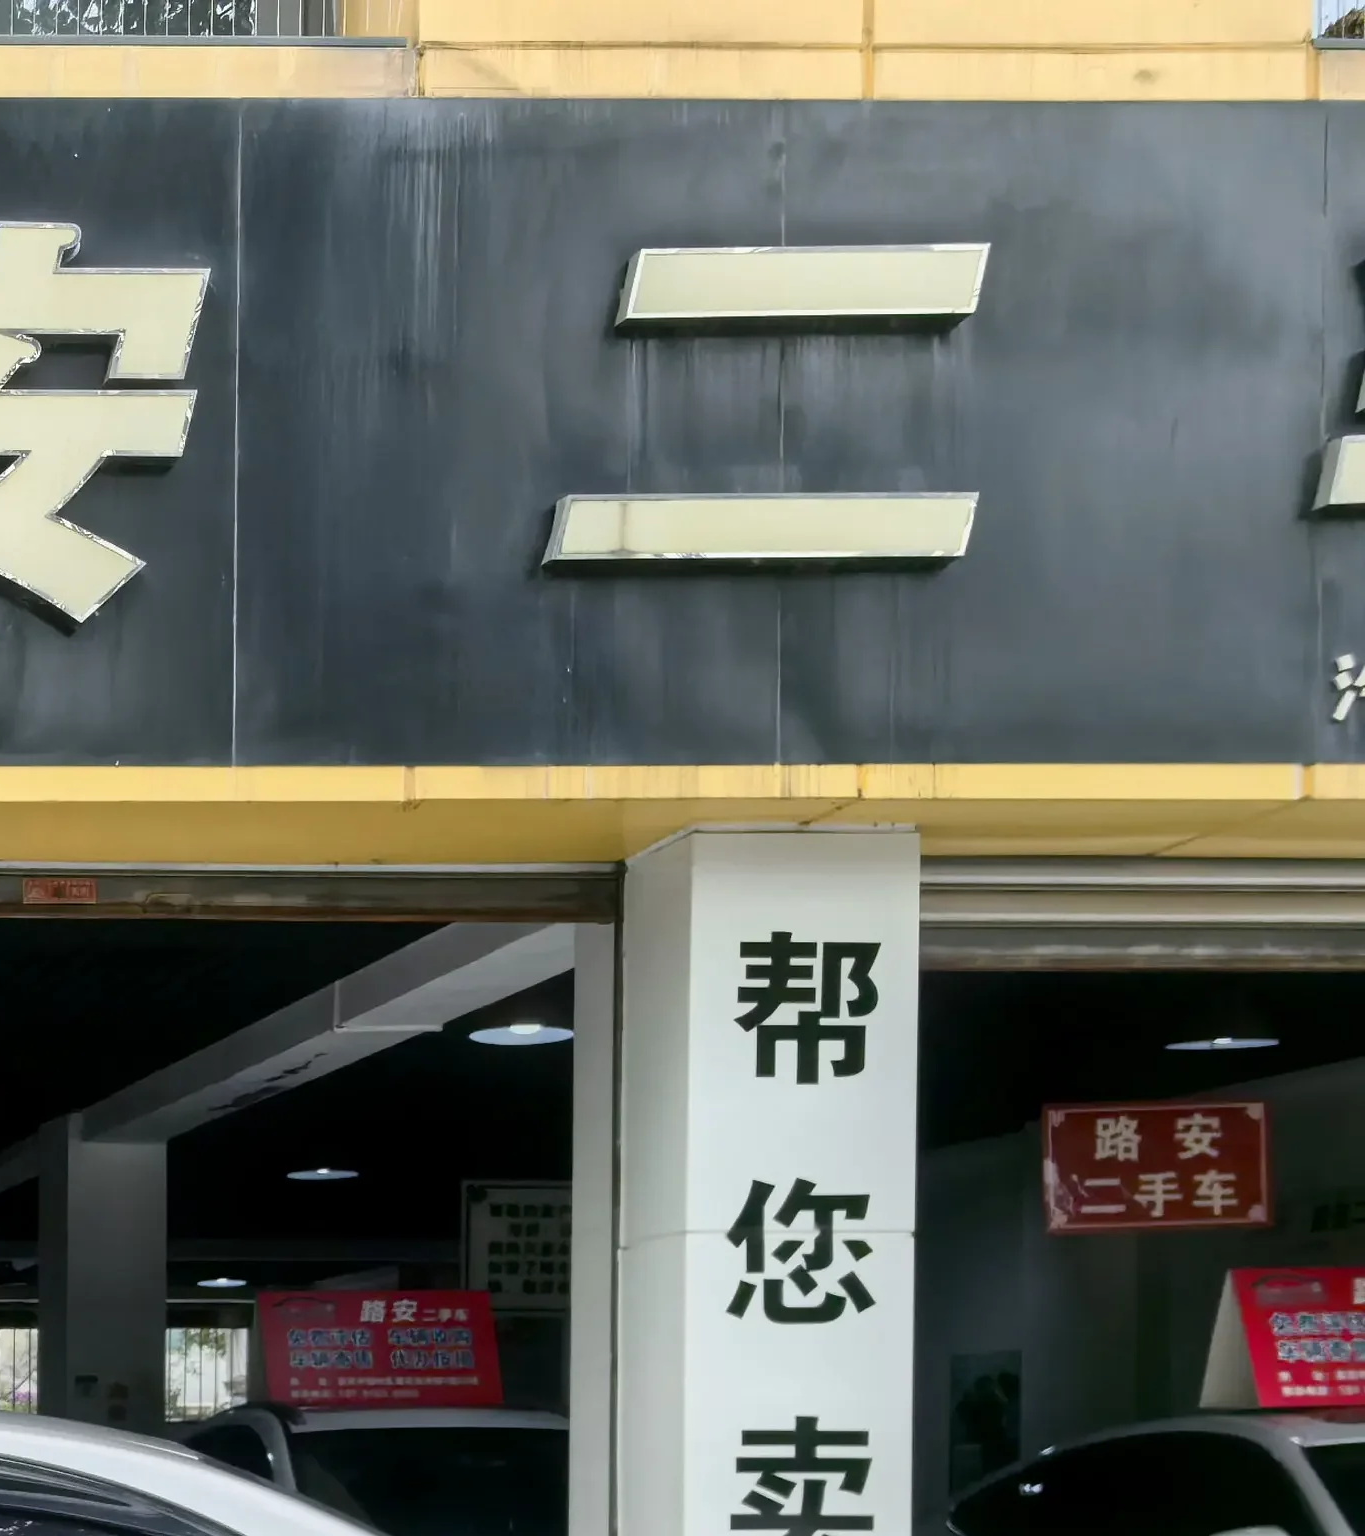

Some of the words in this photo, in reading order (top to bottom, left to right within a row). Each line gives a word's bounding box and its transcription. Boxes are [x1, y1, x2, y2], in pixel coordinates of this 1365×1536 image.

[1093, 1113, 1222, 1162] 路安
[1080, 1169, 1239, 1217] 二手车
